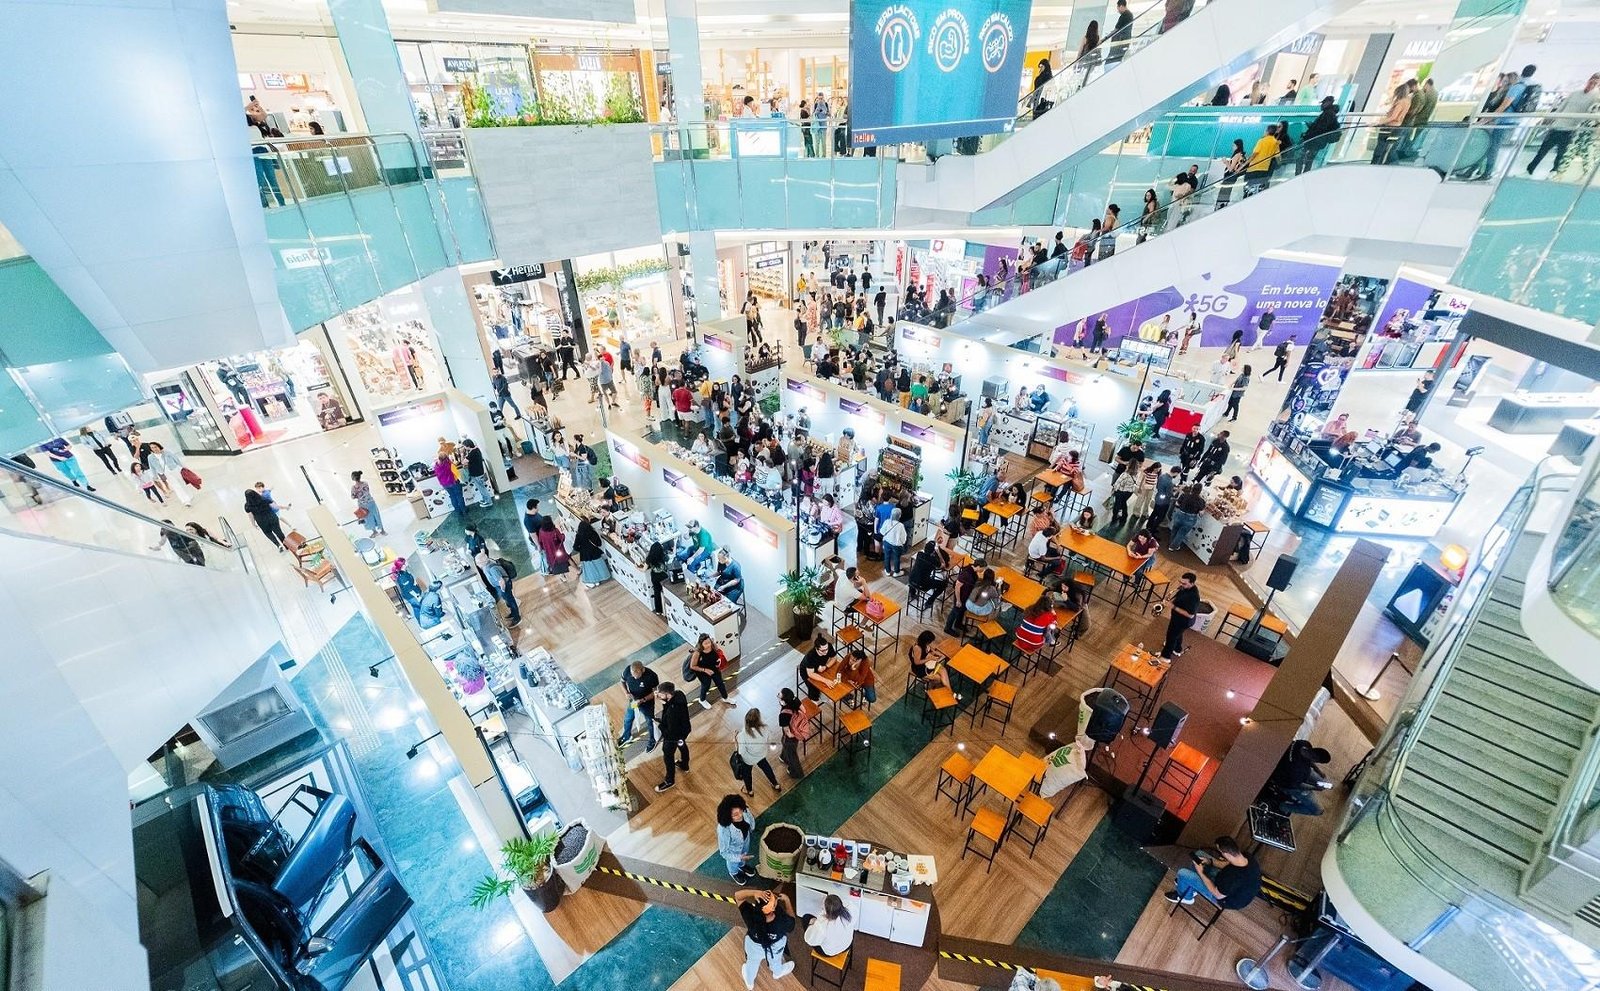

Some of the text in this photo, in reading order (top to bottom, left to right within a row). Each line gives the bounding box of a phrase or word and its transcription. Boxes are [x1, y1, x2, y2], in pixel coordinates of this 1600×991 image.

[875, 4, 920, 40] ZERO LACTOSE
[512, 263, 542, 275] Hering
[1261, 284, 1321, 297] Em breve,
[1198, 295, 1229, 313] 5G
[1256, 299, 1281, 309] uma
[1284, 299, 1312, 309] nova
